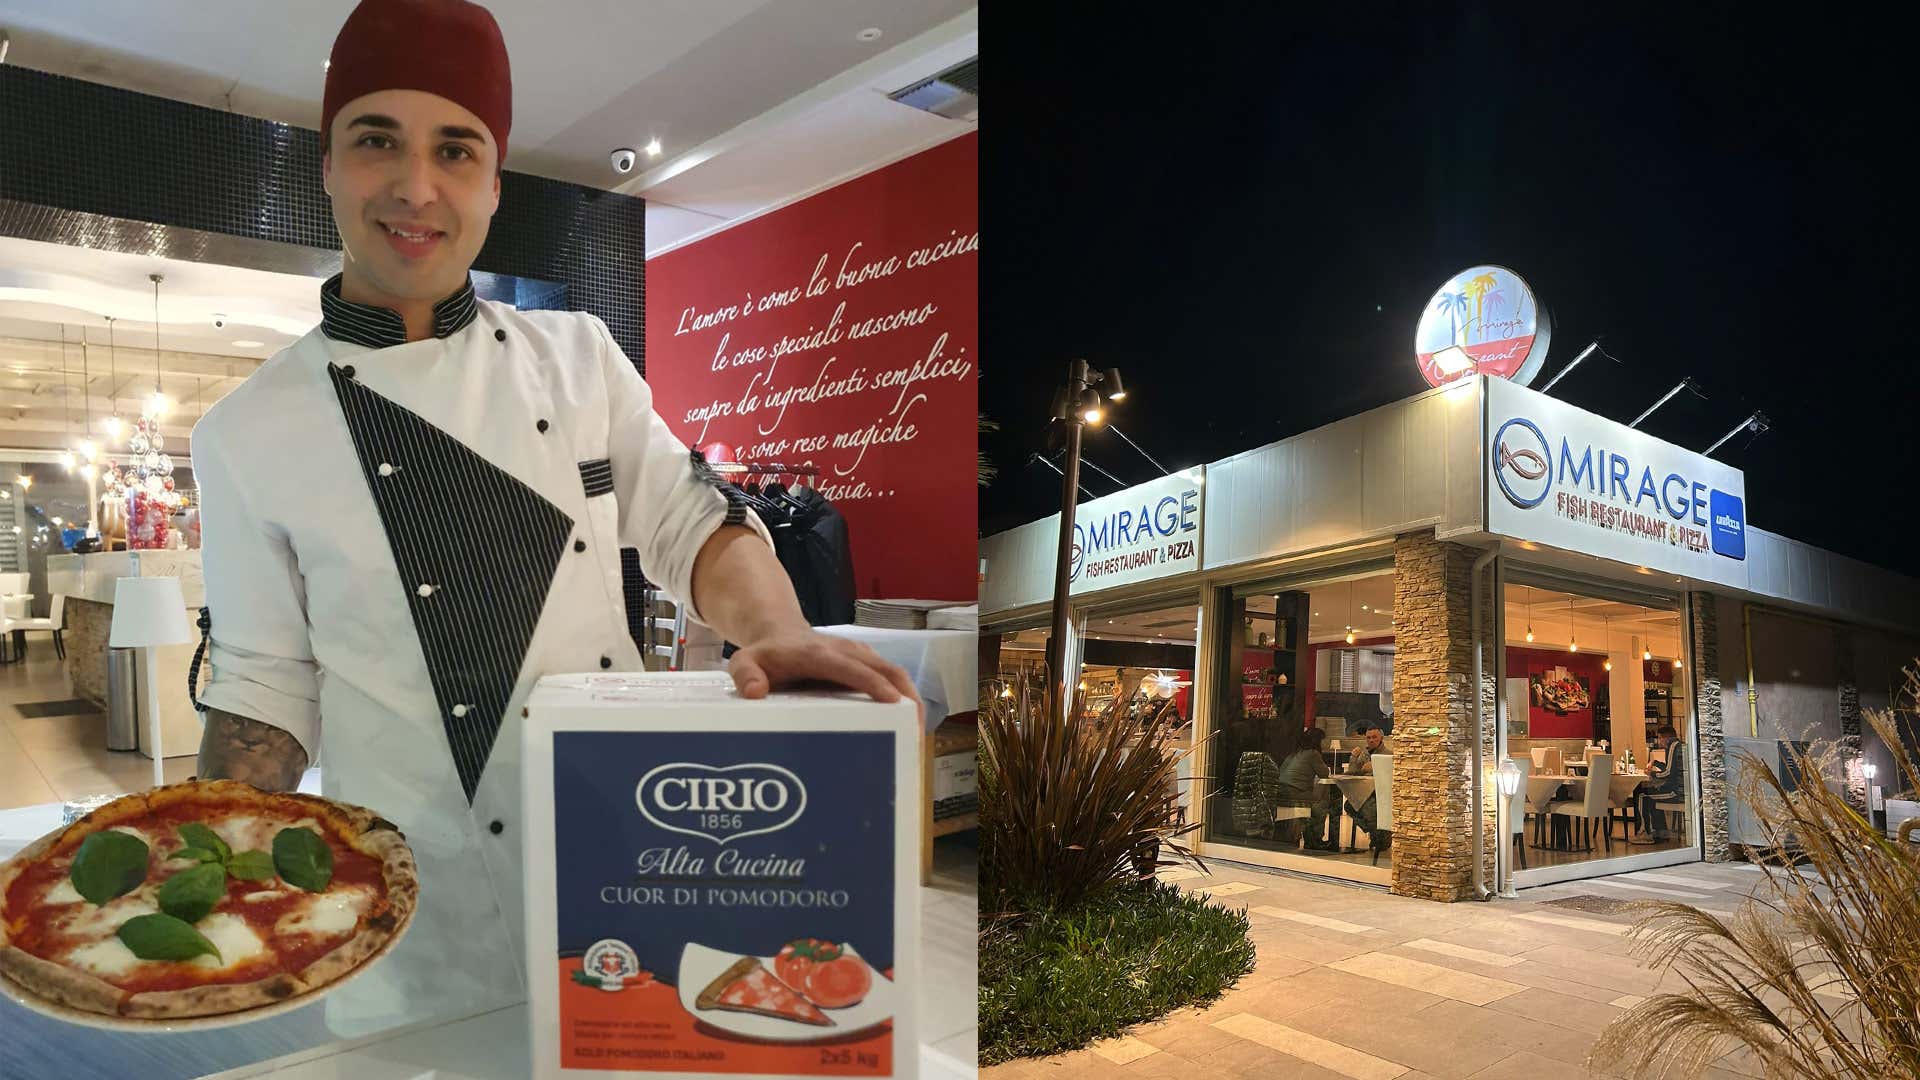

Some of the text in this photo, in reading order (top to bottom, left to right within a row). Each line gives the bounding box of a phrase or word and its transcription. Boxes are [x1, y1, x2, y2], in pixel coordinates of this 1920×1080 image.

[674, 306, 739, 337] L'amore
[743, 293, 753, 317] è
[758, 286, 802, 313] come
[805, 253, 831, 298] la
[836, 241, 902, 290] buona
[711, 301, 938, 386] le cose speciali nascono
[683, 332, 972, 446] sempre da ingredienti semplici,
[747, 440, 790, 461] sono
[792, 432, 830, 455] rese
[832, 394, 927, 476] magiche
[1558, 436, 1708, 527] MIRAGE
[1088, 489, 1198, 554] MIRAGE
[1557, 492, 1710, 552] FISH RESTAURANT & PIZZA
[1086, 540, 1195, 579] FISH RESTAURANT & PIZZA
[653, 777, 788, 813] CIRIO
[700, 814, 743, 830] 1856
[637, 845, 806, 877] Alta Cucina
[601, 886, 850, 908] CUOR DI POMODORO
[821, 1048, 879, 1069] 2x5 kg
